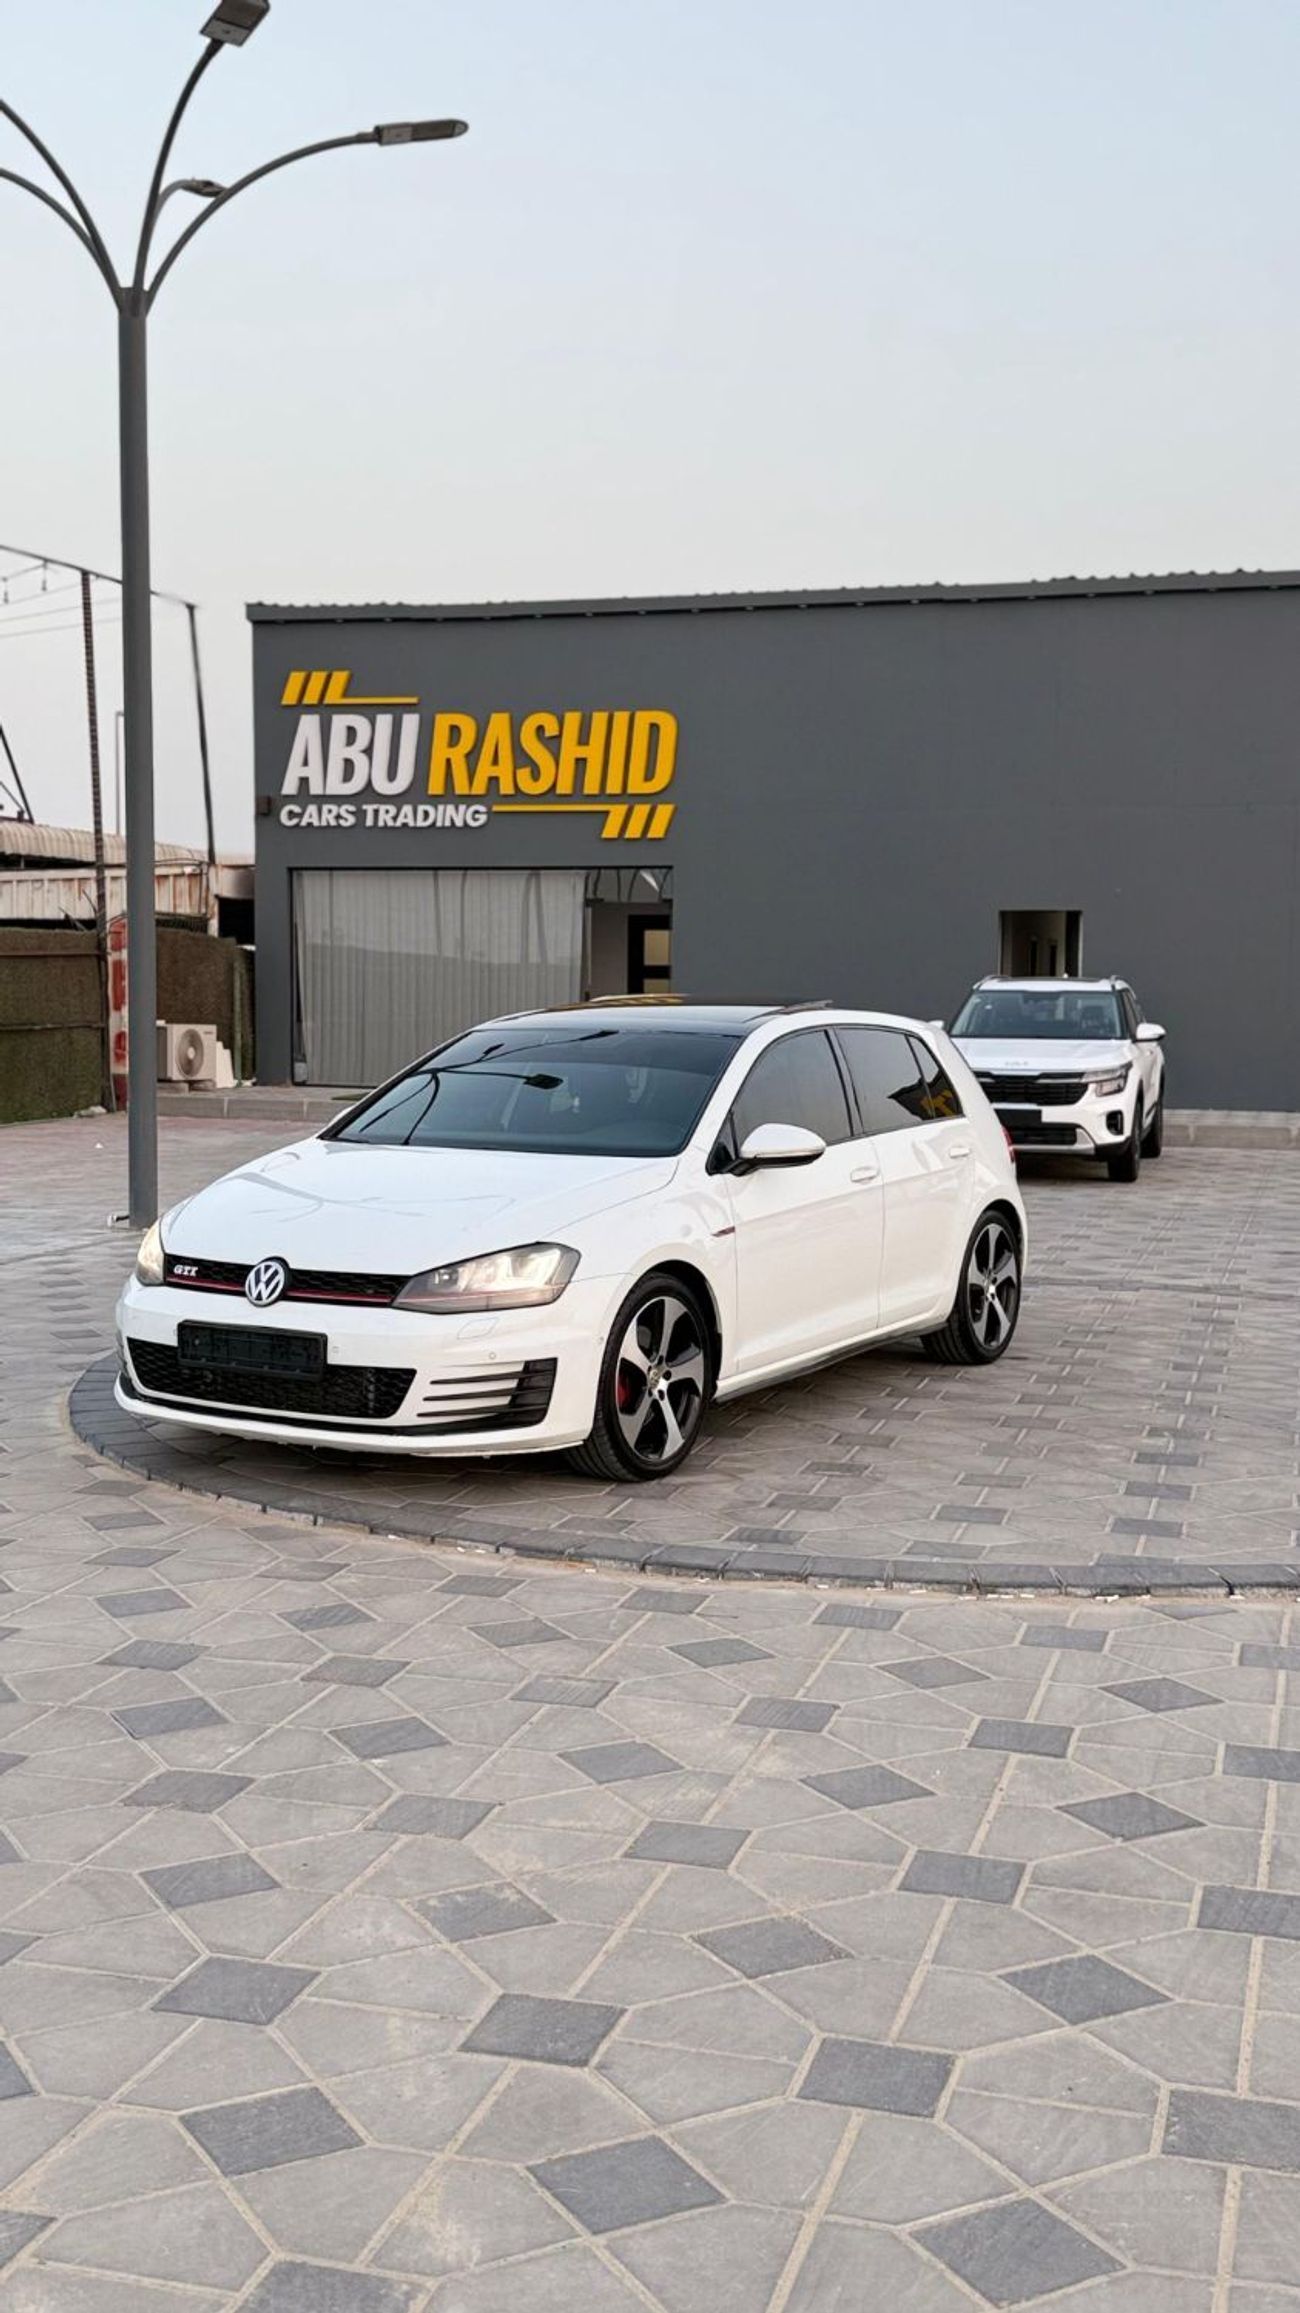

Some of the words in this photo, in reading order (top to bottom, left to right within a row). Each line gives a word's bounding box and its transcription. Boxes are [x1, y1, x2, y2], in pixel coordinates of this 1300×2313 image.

[281, 713, 420, 796] ABU
[427, 710, 679, 796] RASHID
[280, 804, 356, 827] CARS
[362, 804, 488, 828] TRADING
[173, 1264, 198, 1276] GTI
[246, 1261, 285, 1305] VW
